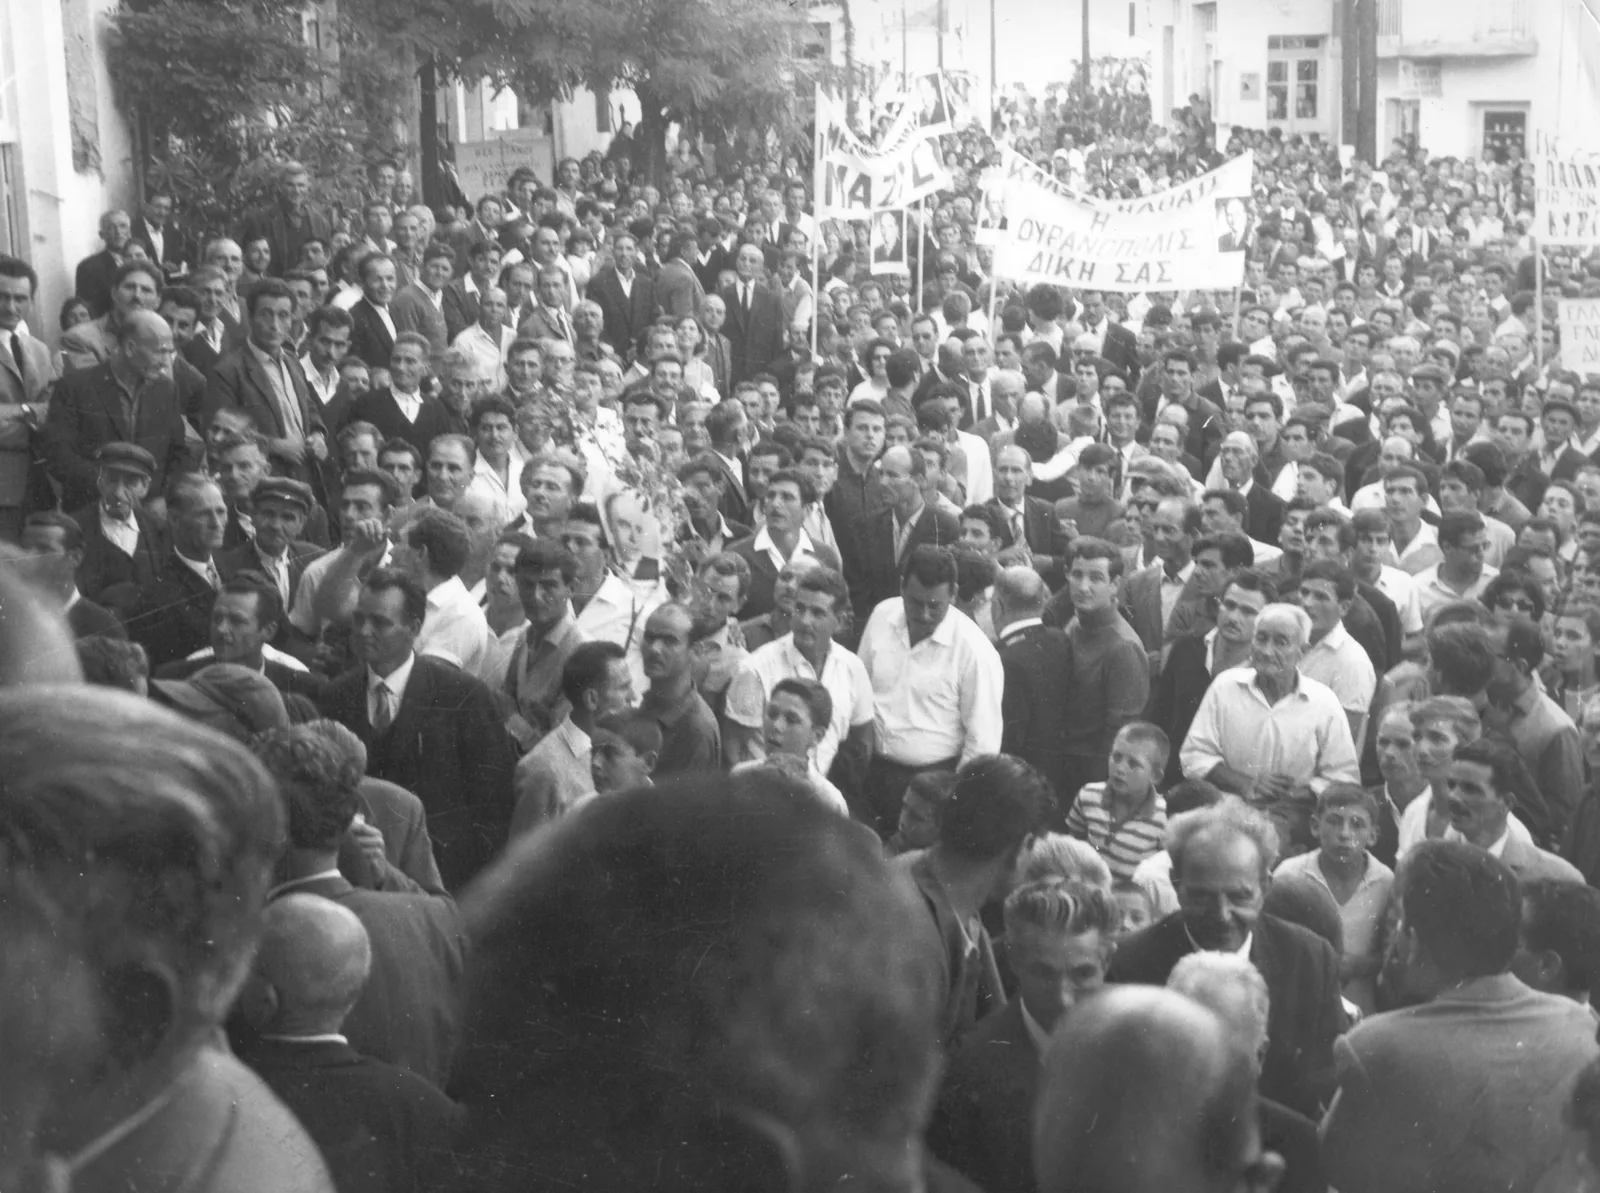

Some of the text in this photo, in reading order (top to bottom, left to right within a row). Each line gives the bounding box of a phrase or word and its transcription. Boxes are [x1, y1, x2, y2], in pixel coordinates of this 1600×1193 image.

[1015, 218, 1193, 257] ΟΥΡΑΝΟΠΟΛΙΣ
[1089, 211, 1109, 231] Η
[1023, 250, 1172, 284] ΔΙΚΗ ΣΑΣ
